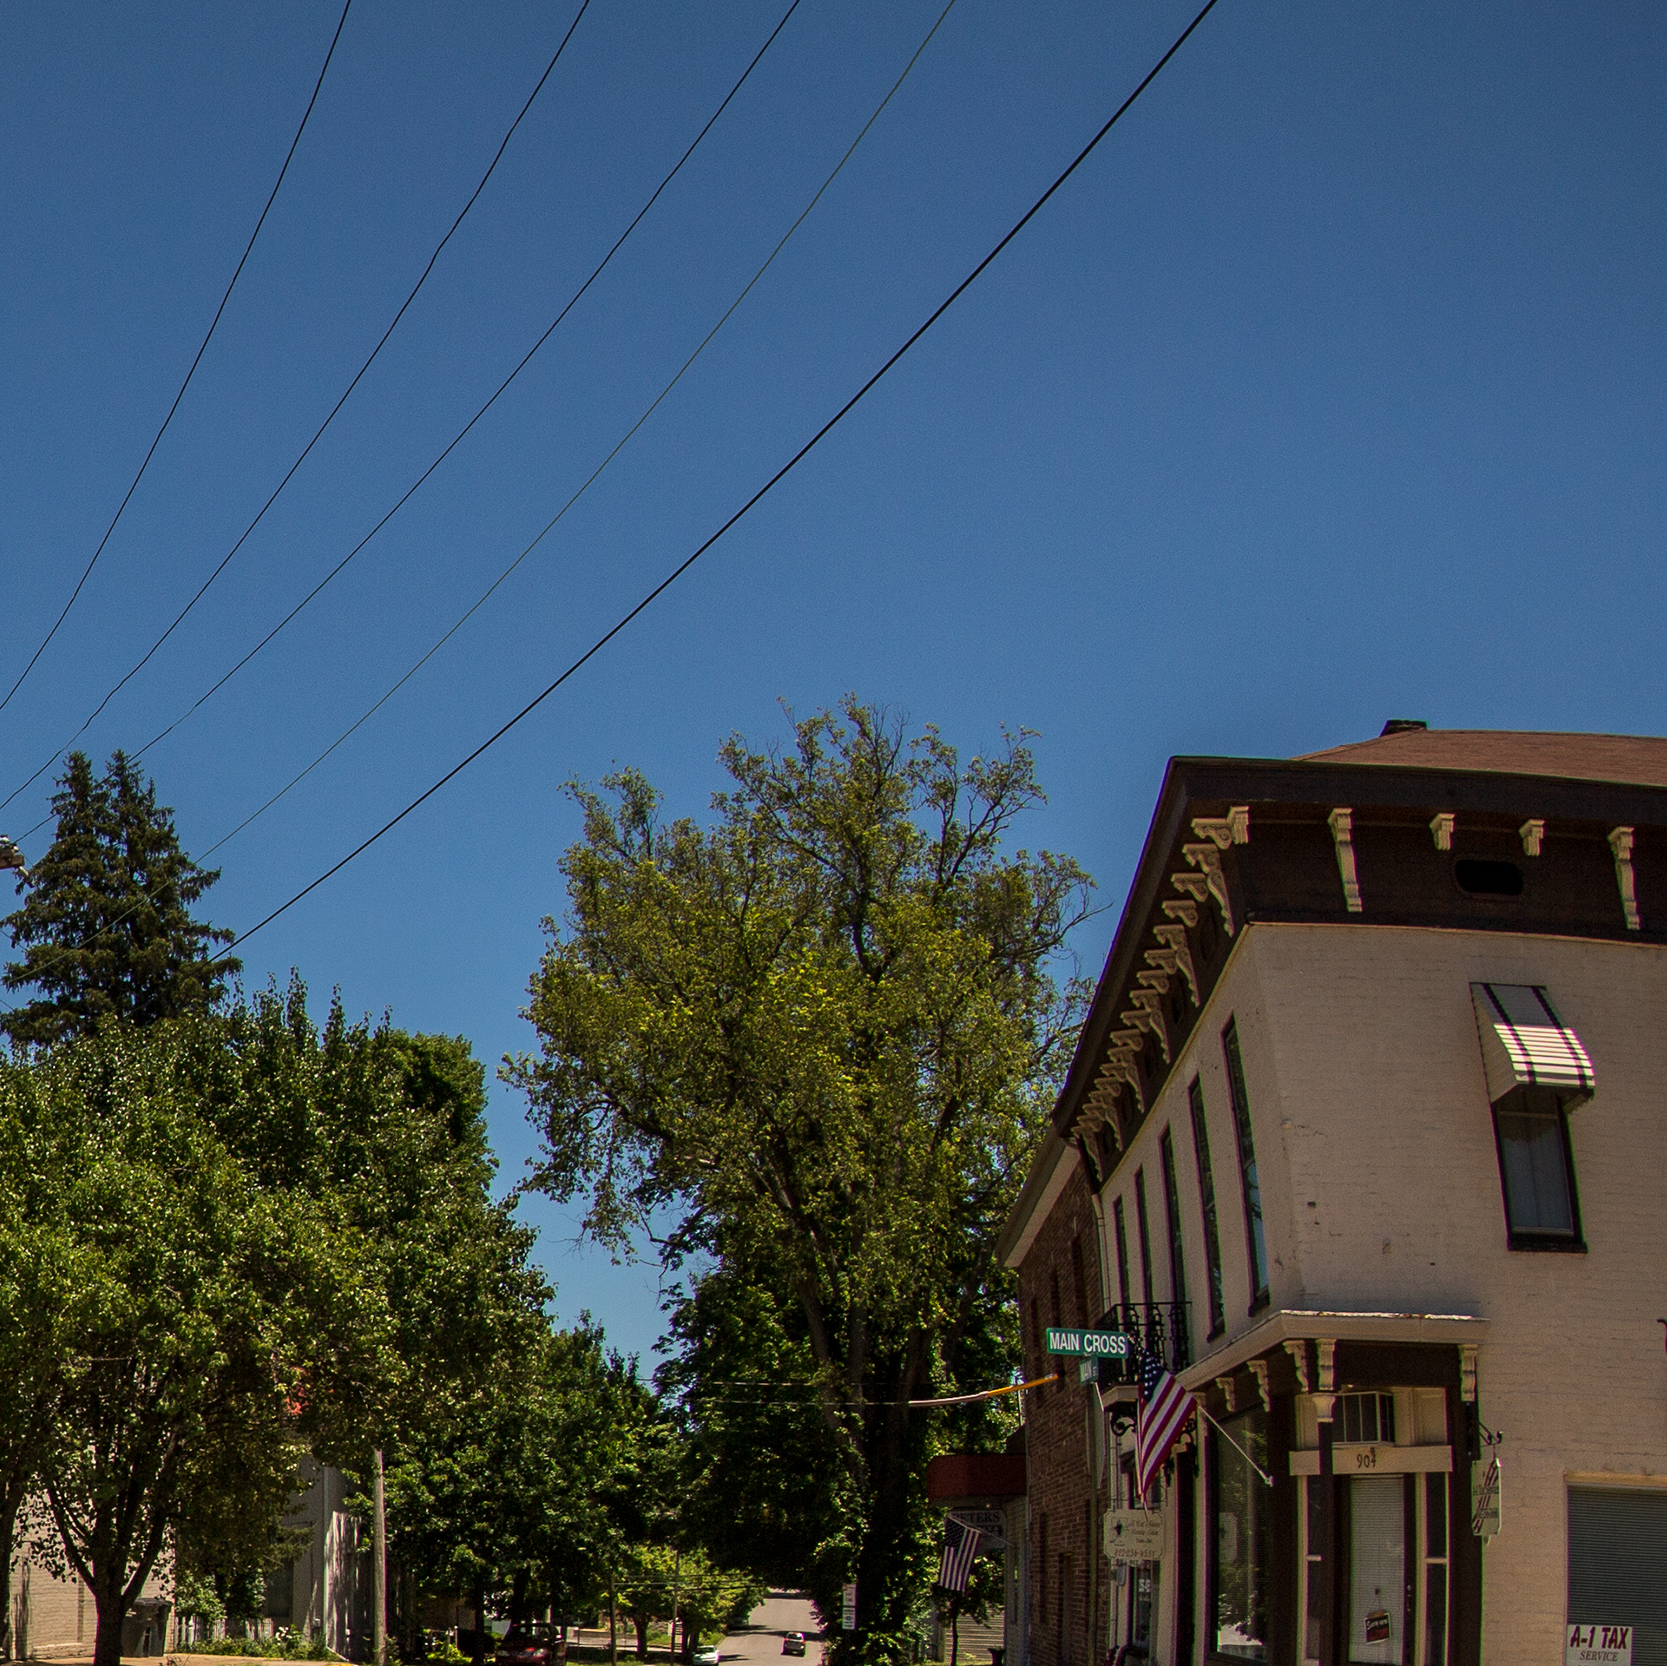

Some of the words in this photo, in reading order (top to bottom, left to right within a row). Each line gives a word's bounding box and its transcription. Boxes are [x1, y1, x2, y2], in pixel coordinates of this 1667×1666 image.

[1050, 1332, 1080, 1351] MAIN
[1084, 1334, 1126, 1354] CROSS
[1569, 1625, 1596, 1648] A-1
[1601, 1627, 1629, 1650] TAX
[1579, 1650, 1618, 1662] SERVICE
